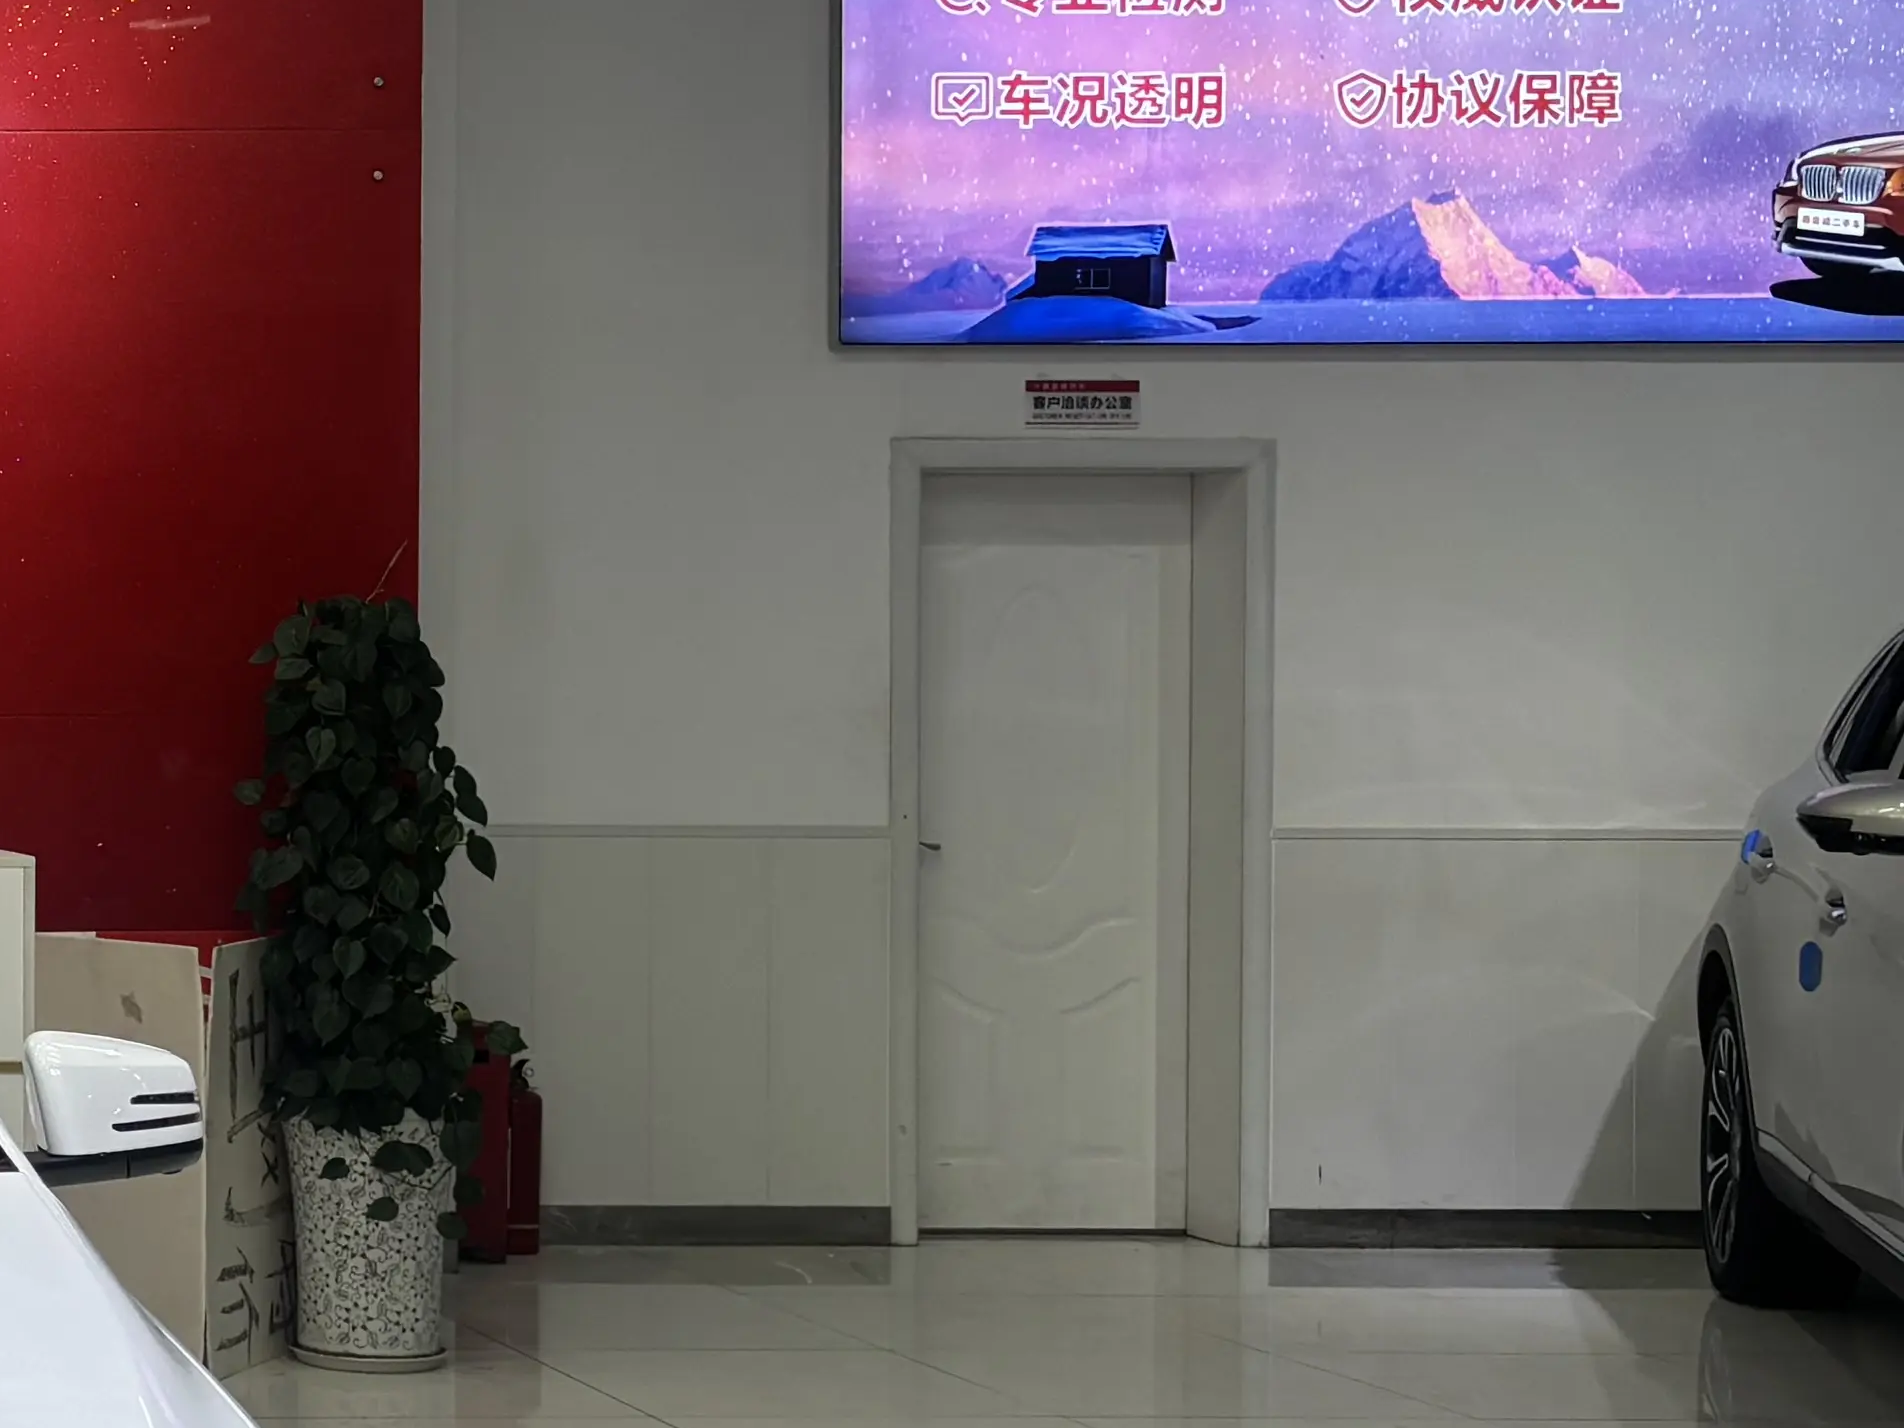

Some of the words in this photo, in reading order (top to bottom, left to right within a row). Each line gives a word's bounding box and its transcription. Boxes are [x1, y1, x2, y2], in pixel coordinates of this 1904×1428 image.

[995, 71, 1227, 130] 车况透明
[1390, 71, 1623, 130] 协议保障
